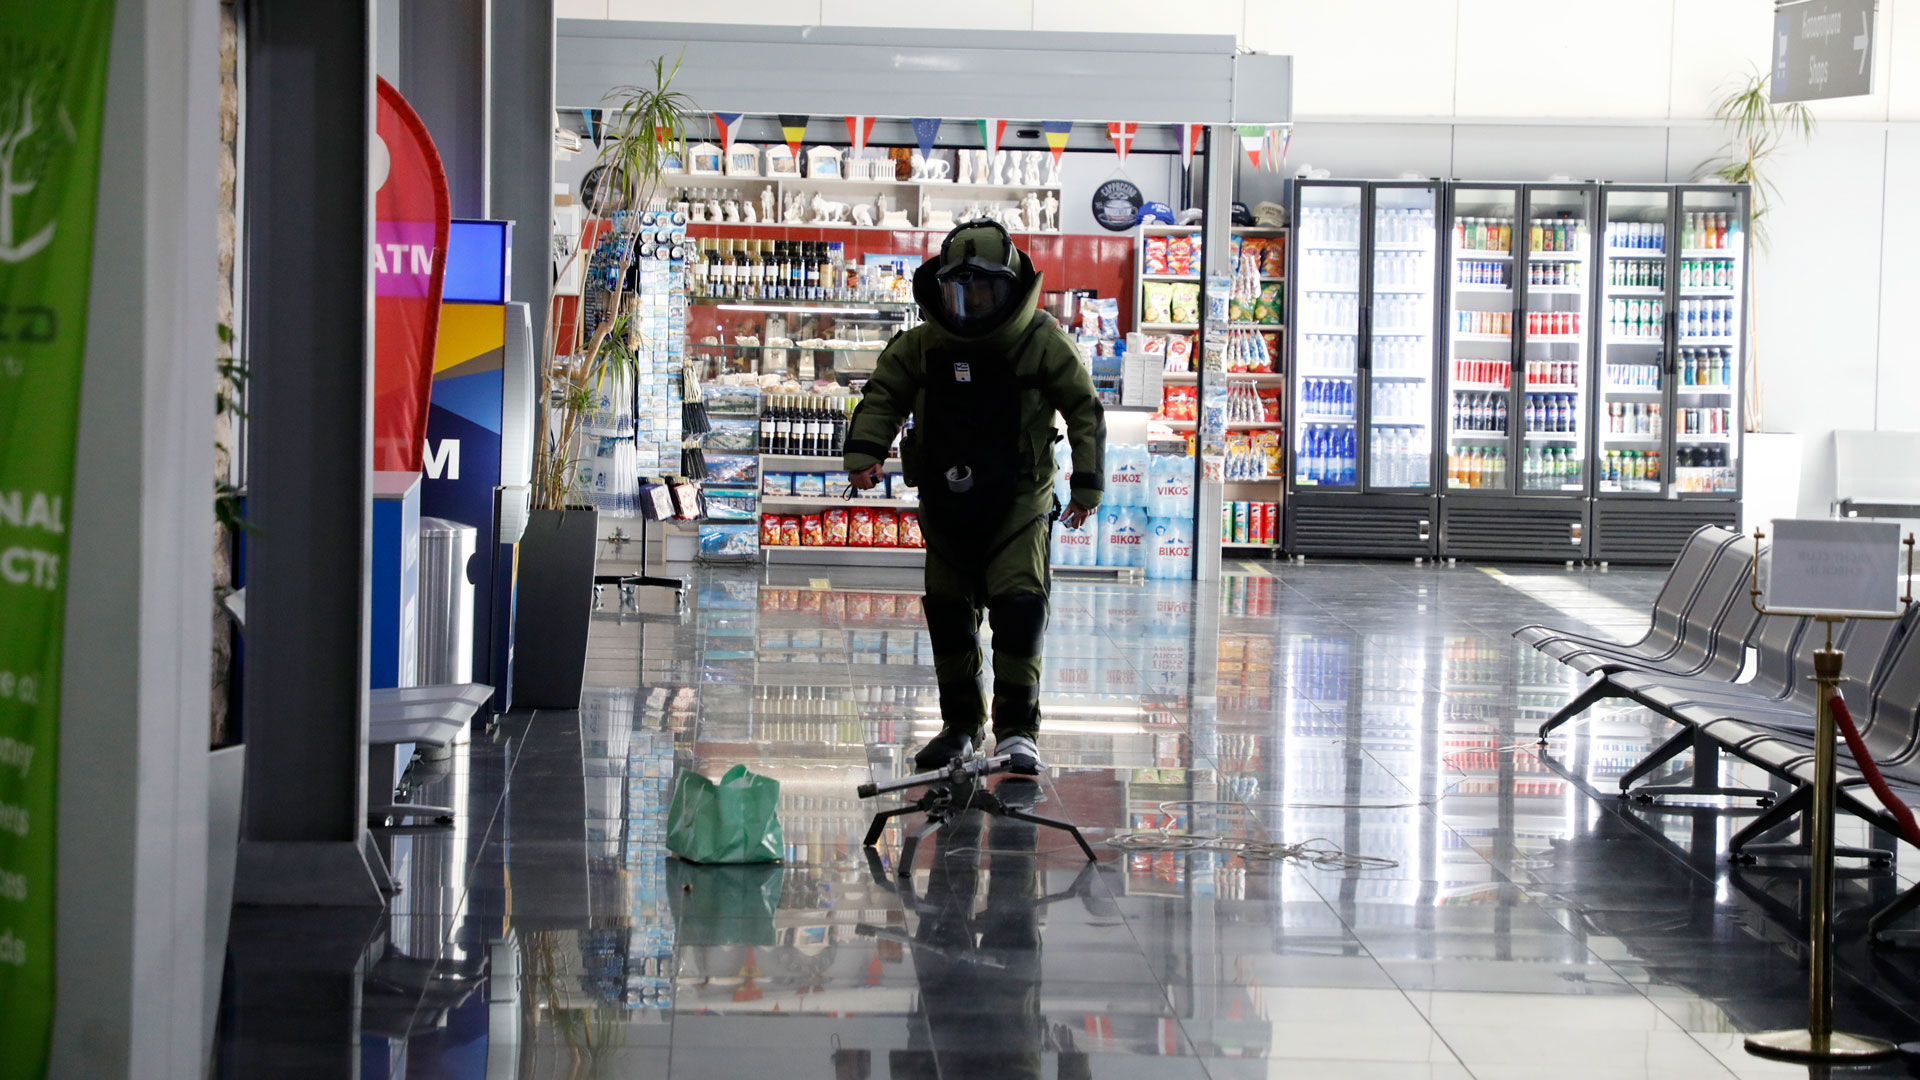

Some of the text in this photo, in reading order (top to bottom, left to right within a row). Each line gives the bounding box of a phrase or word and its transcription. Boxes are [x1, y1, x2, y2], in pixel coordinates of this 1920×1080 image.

[1808, 54, 1829, 92] Shops
[375, 243, 436, 275] ATM
[1112, 473, 1141, 484] ΒΙΚΟΣ
[1157, 486, 1189, 496] VIKOS
[1060, 535, 1092, 545] ΒΙΚΟΣ
[1110, 534, 1141, 545] ΒΙΚΟΣ
[1159, 546, 1190, 557] ΒΙΚΟΣ
